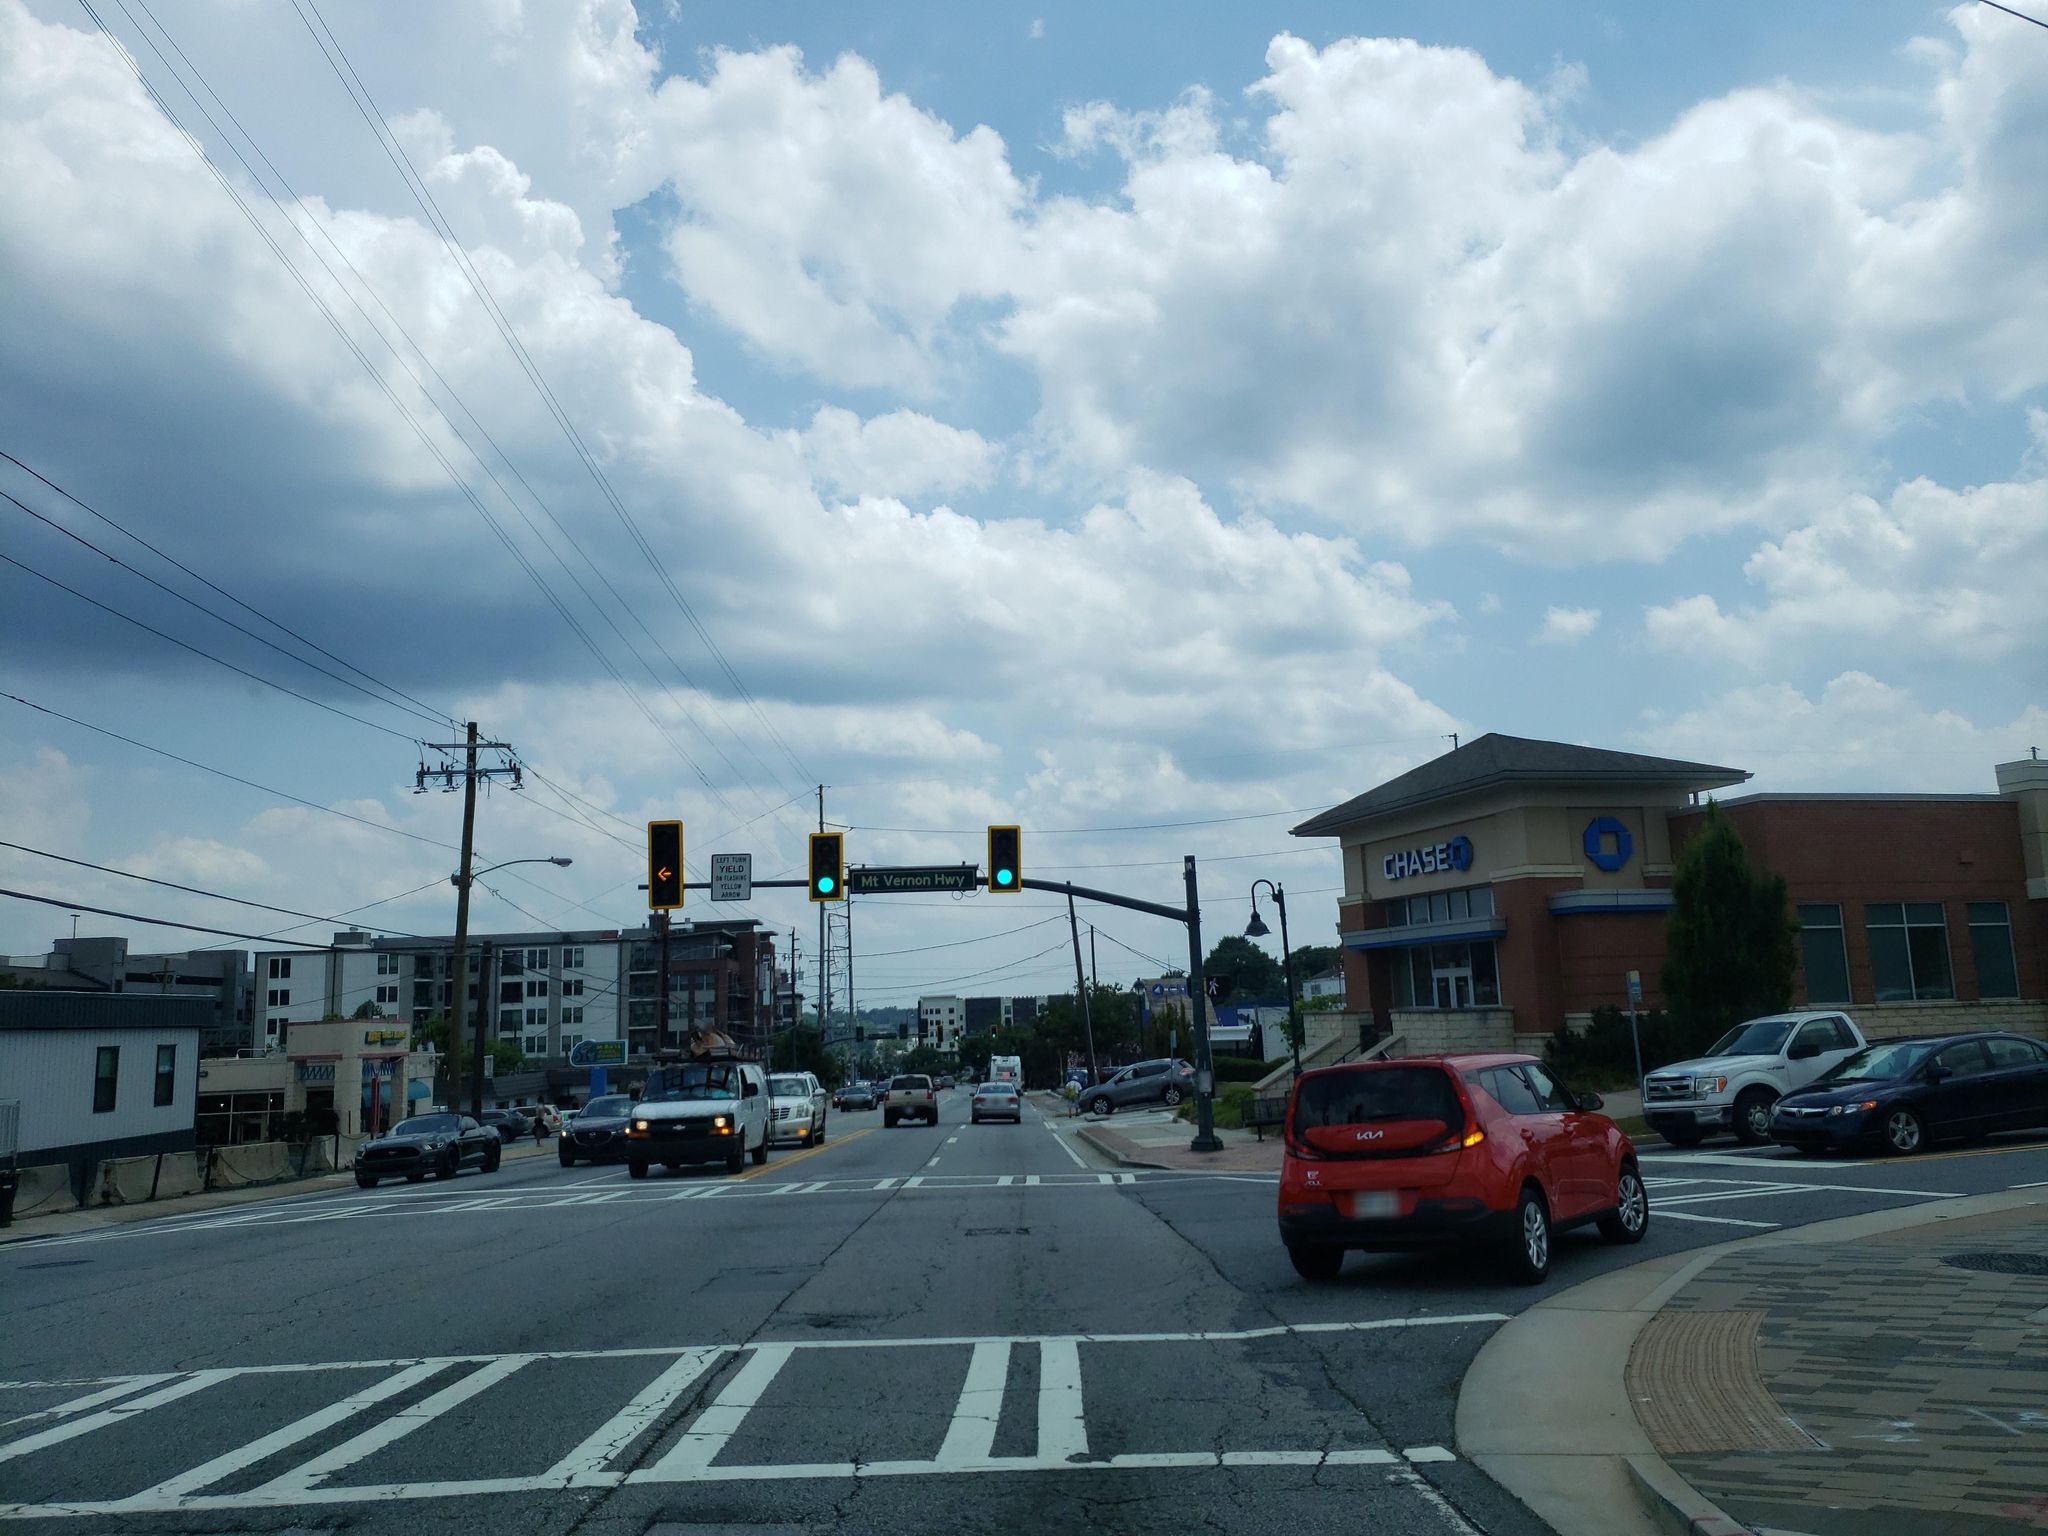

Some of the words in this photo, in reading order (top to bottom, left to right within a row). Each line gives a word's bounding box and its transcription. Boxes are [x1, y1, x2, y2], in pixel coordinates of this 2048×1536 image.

[1383, 843, 1449, 879] CHASE
[719, 865, 744, 873] YIELD
[861, 875, 879, 888] Mt
[883, 874, 932, 887] Vernon
[934, 873, 965, 887] Hwy
[1356, 1130, 1384, 1141] KIA
